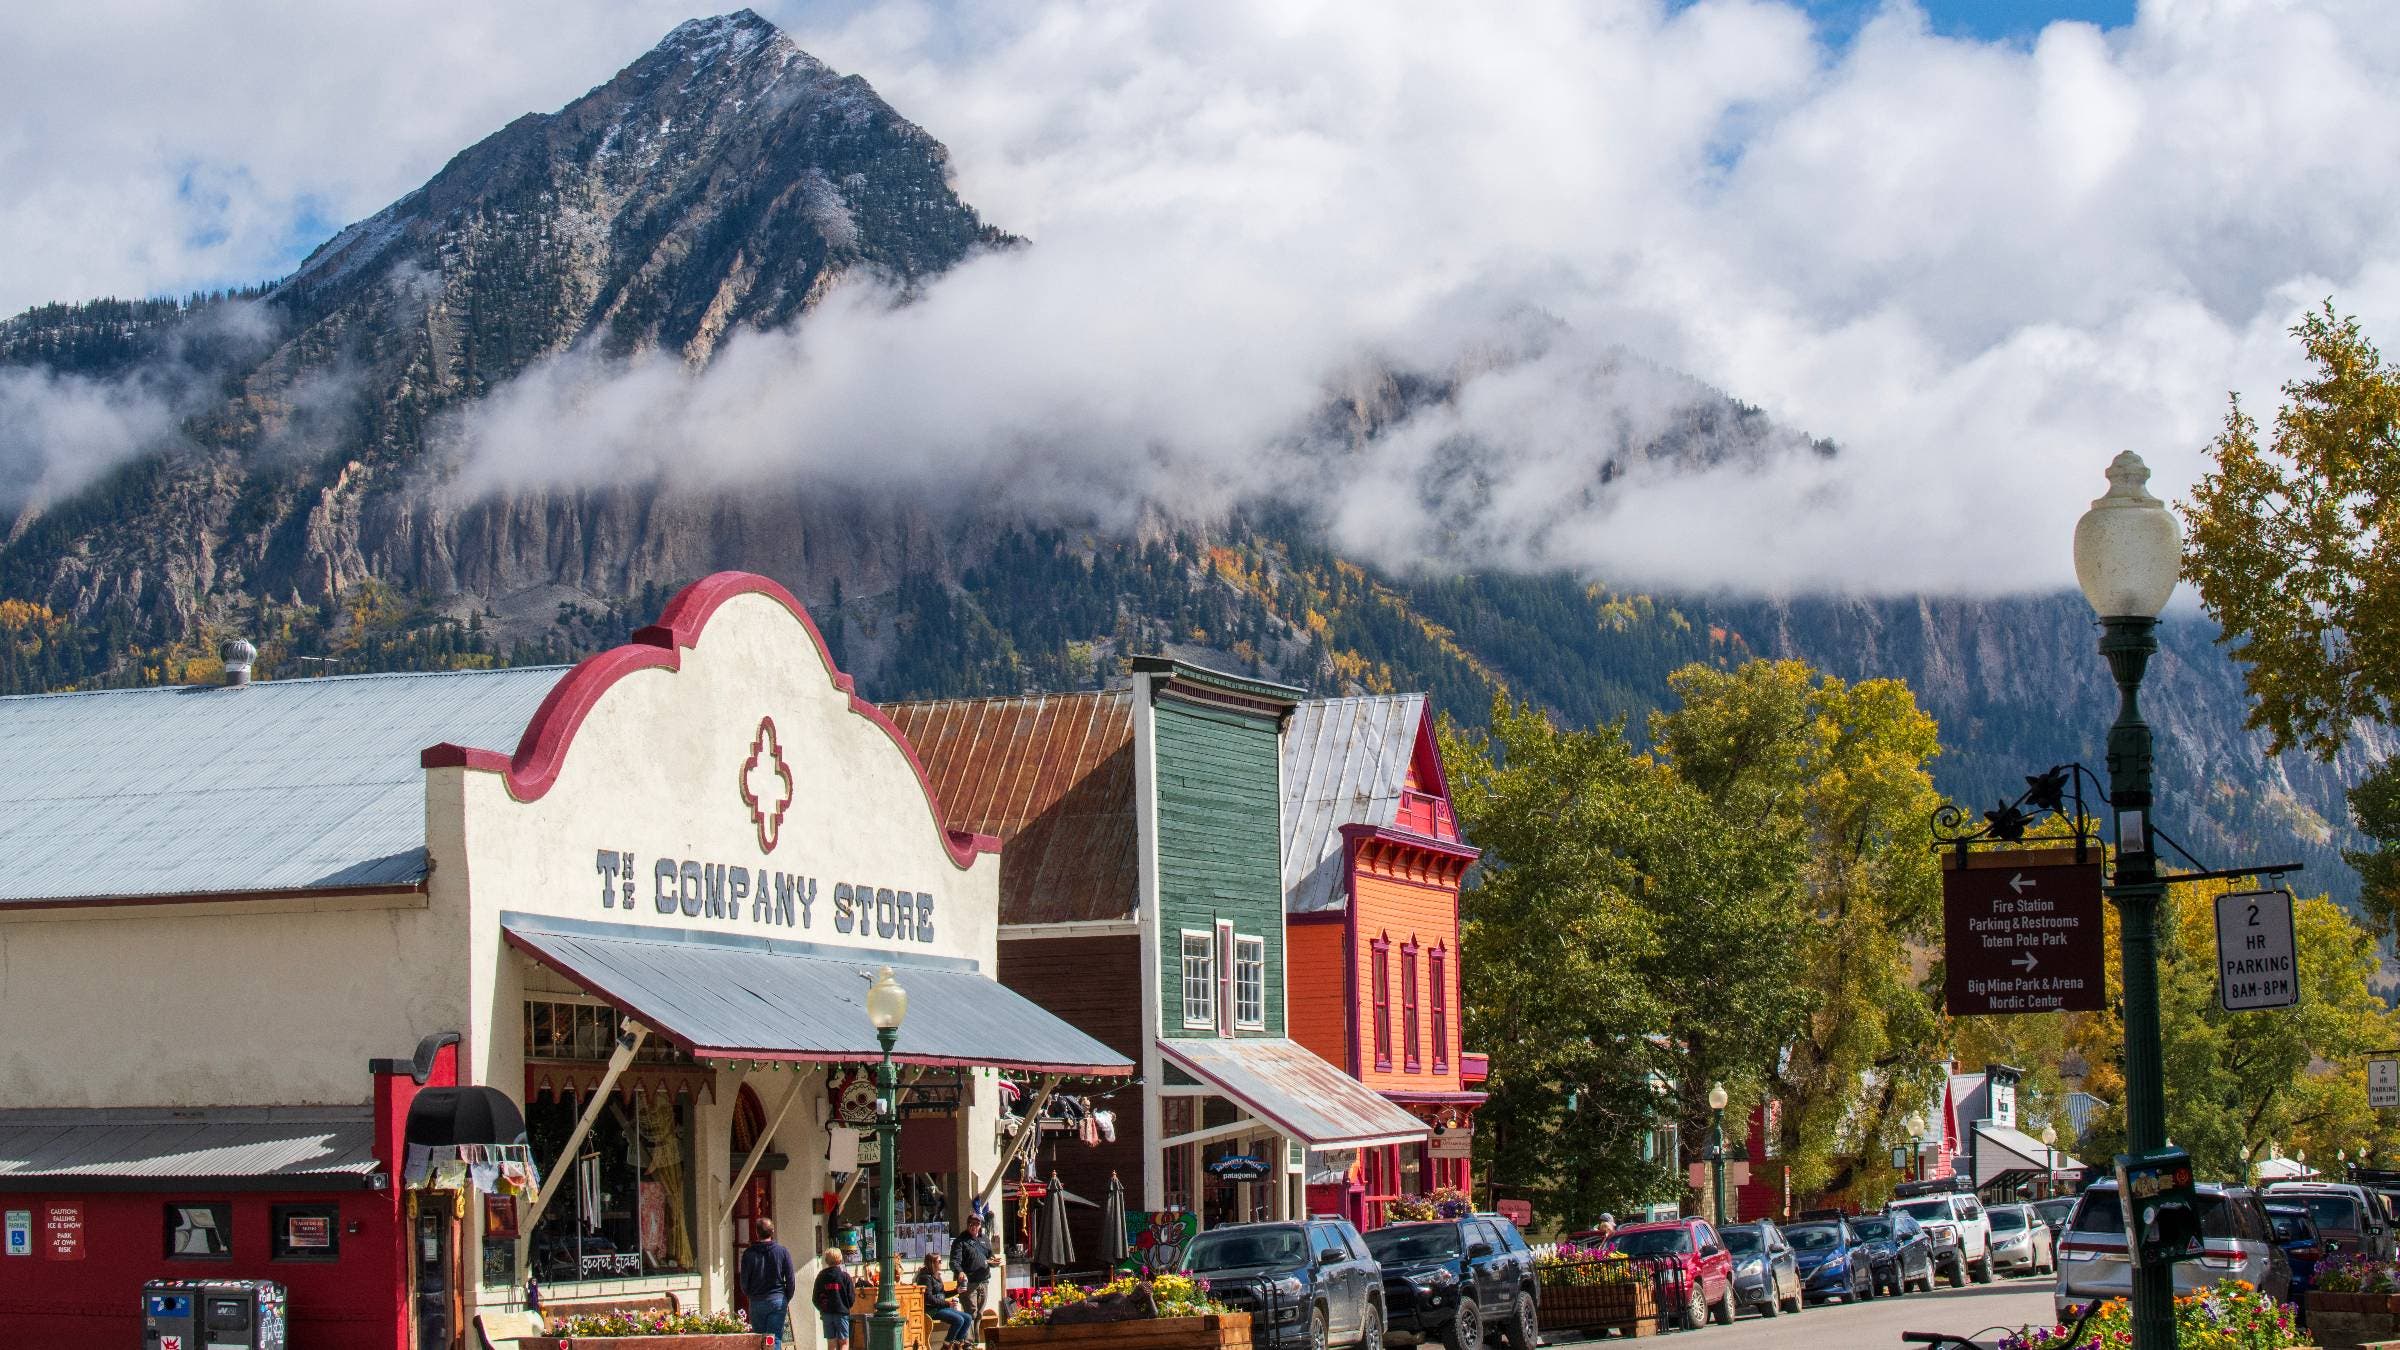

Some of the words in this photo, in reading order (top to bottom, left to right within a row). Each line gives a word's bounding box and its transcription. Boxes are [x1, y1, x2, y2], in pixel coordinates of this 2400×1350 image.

[655, 858, 818, 929] COMPANY
[833, 882, 935, 943] STORE
[1993, 900, 2014, 913] Fire
[2017, 899, 2054, 912] Station
[1969, 917, 2011, 932] Parking
[2013, 918, 2020, 929] &
[2022, 916, 2079, 929] Restrooms
[2247, 905, 2260, 927] 2
[1981, 935, 2013, 948] Totem
[2016, 934, 2039, 946] Pole
[2042, 932, 2068, 945] Park
[2246, 935, 2266, 950] HR
[2227, 956, 2289, 976] PARKING
[1968, 980, 1985, 995] Big
[1987, 979, 2013, 992] Mine
[2015, 978, 2040, 991] Park
[2042, 979, 2050, 990] &
[2052, 977, 2084, 990] Arena
[2232, 979, 2288, 999] 8AM-8PM
[1989, 995, 2025, 1009] Nordic
[2028, 995, 2063, 1008] Center
[2380, 1064, 2386, 1074] 2
[1223, 1172, 1257, 1180] patagonia
[582, 1254, 612, 1276] secret
